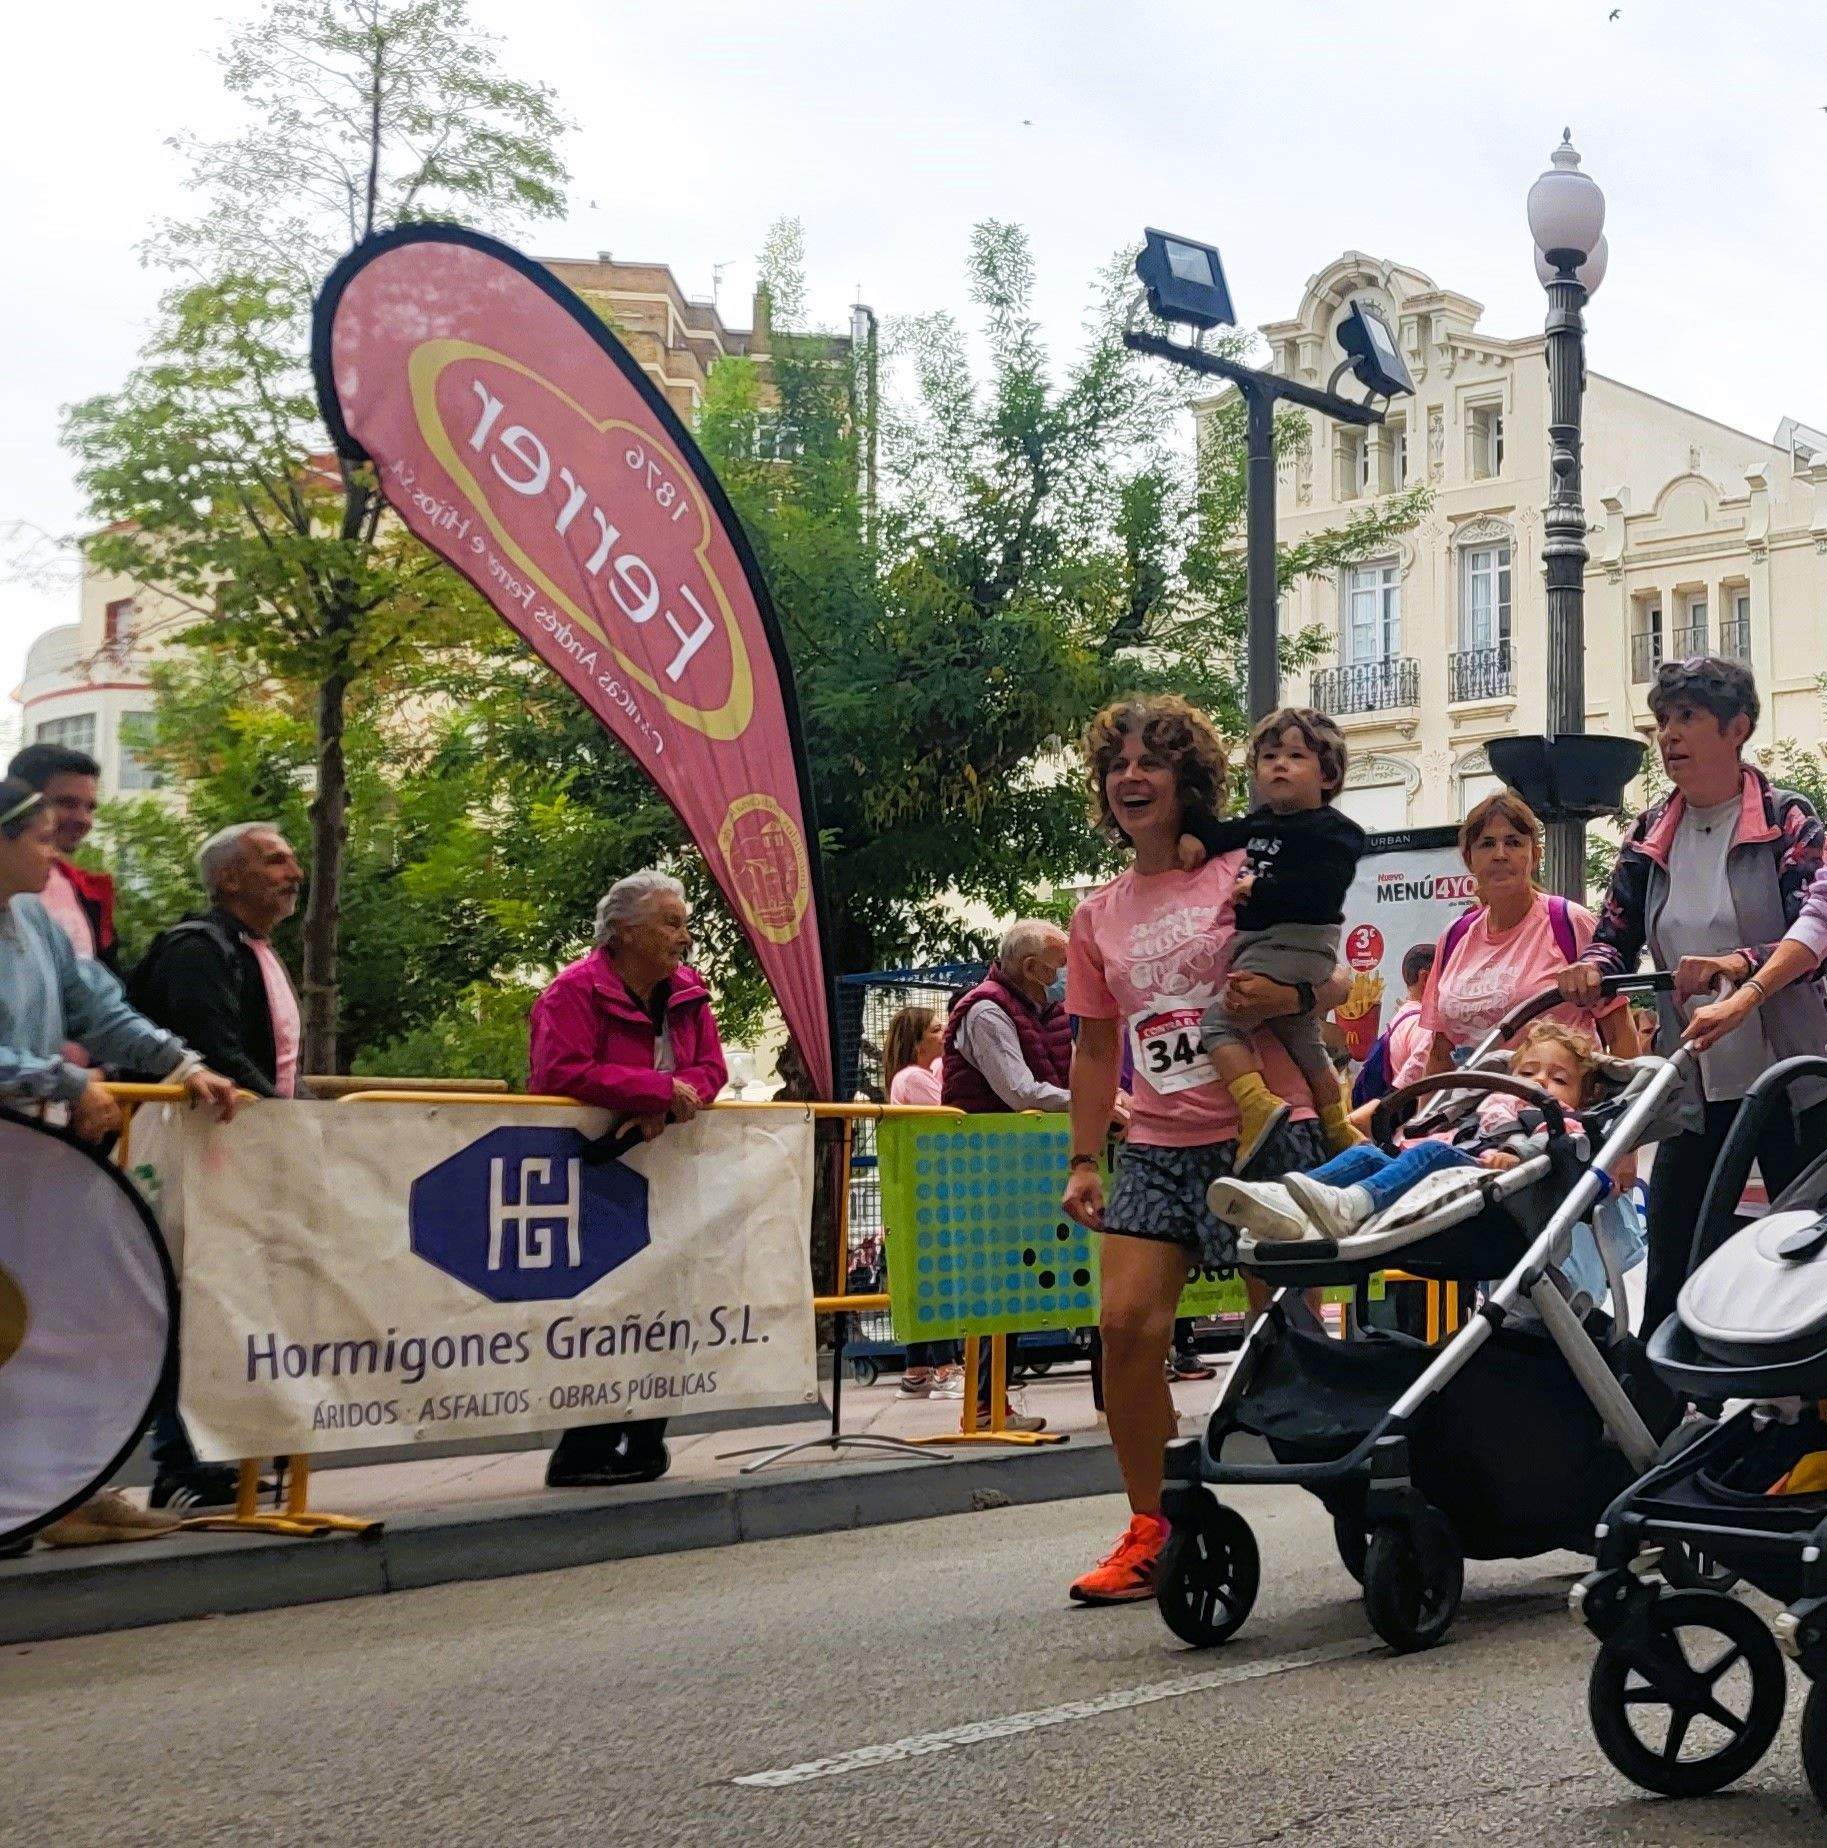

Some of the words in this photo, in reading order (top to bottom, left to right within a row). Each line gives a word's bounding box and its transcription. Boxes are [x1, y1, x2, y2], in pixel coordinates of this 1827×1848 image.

[1370, 835, 1411, 847] URBAN
[1377, 874, 1433, 903] MENÚ
[247, 1327, 530, 1384] Hormigones
[546, 1310, 699, 1361] Grañén,
[706, 1304, 770, 1347] S.L.
[312, 1399, 399, 1431] ÁRIDOS
[418, 1389, 530, 1422] ASFALTOS
[549, 1381, 621, 1410] OBRAS
[628, 1371, 718, 1401] PÚBLICAS
